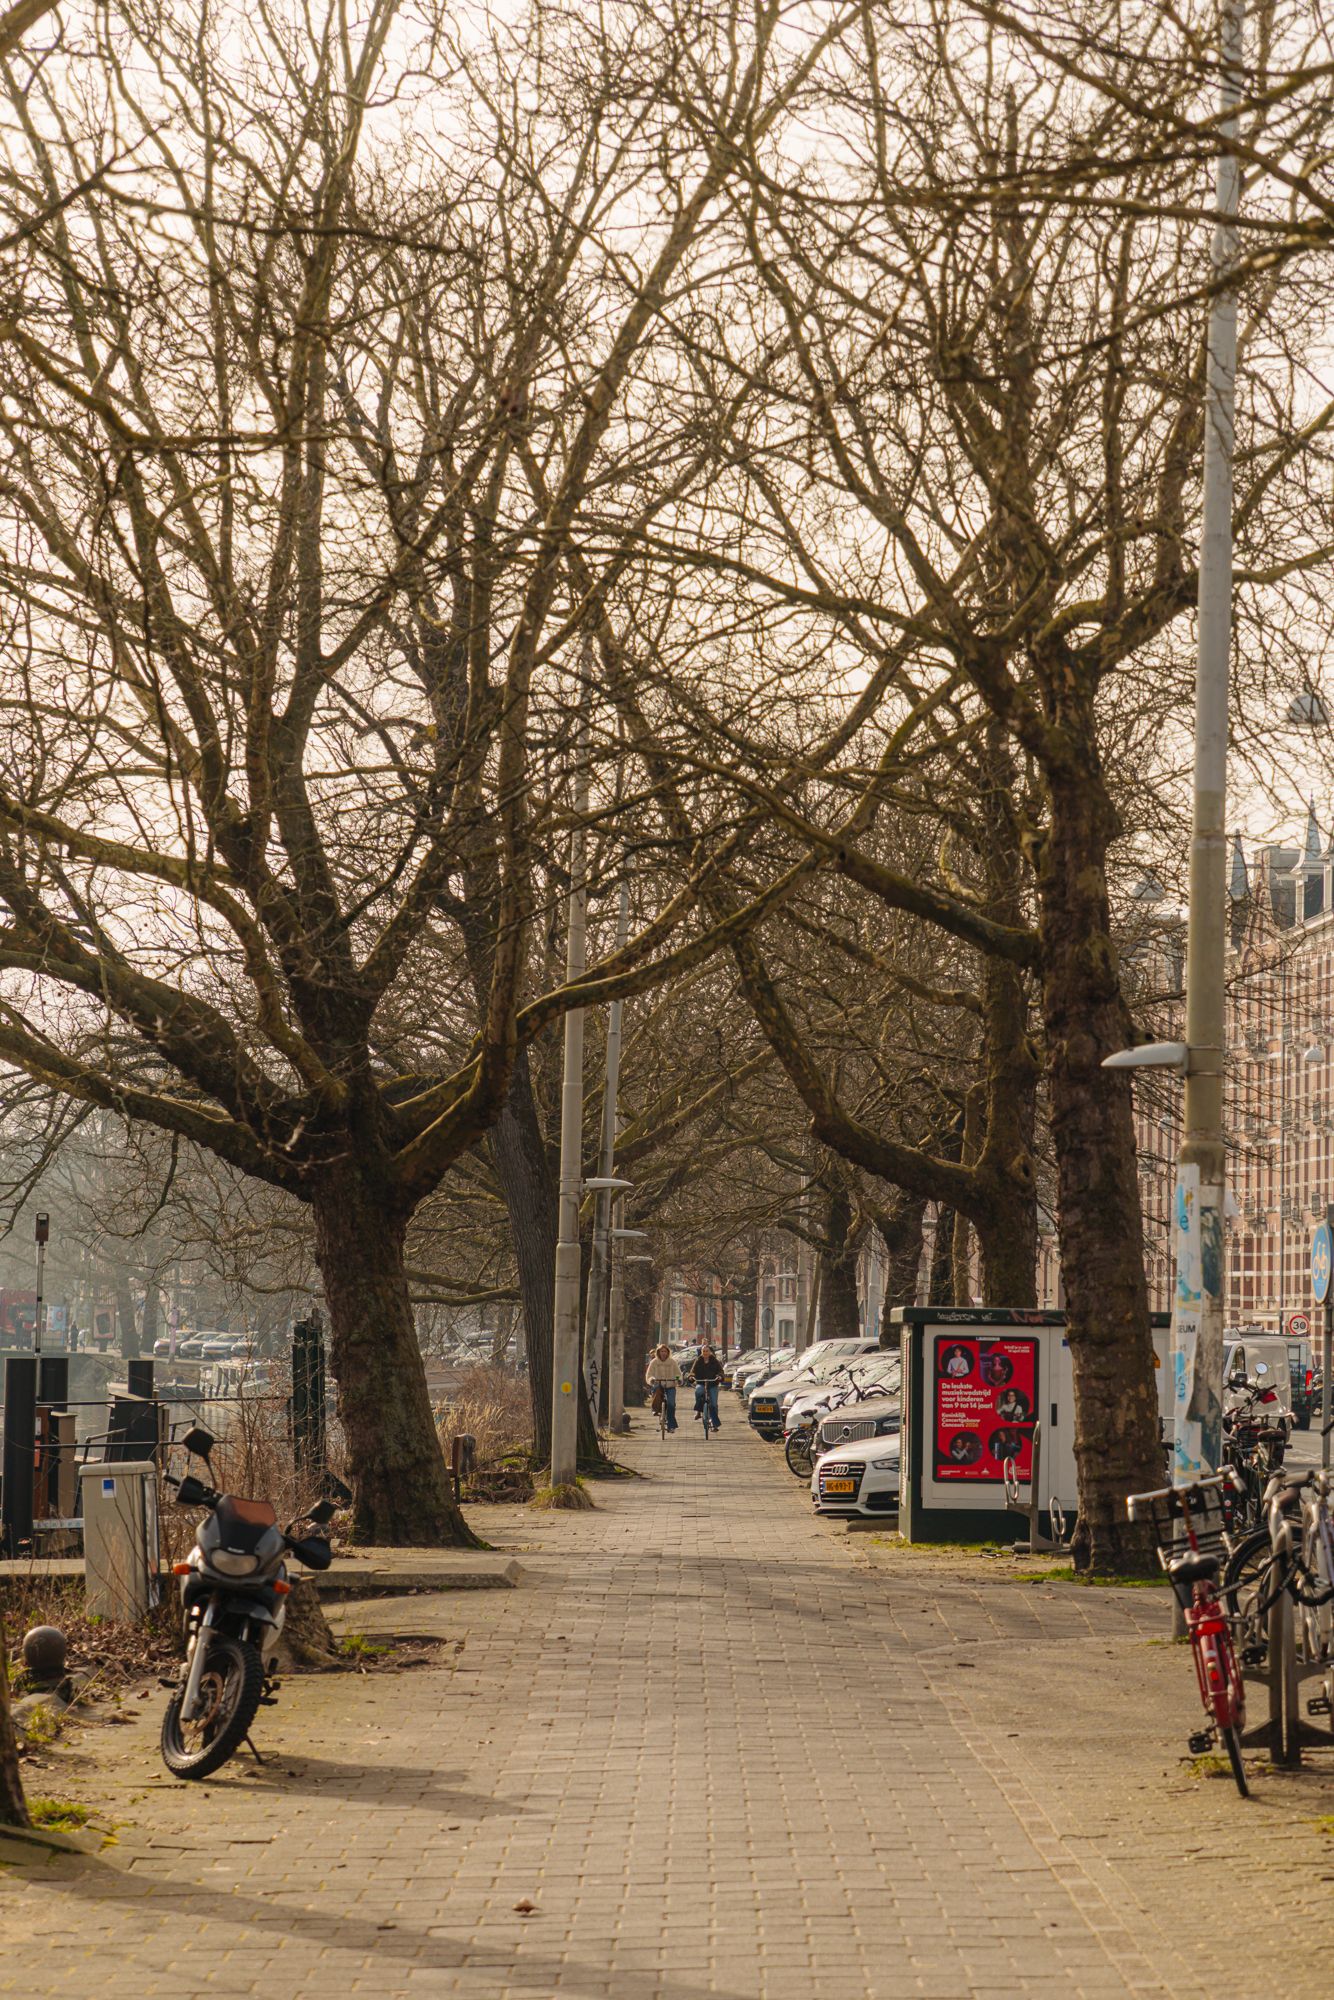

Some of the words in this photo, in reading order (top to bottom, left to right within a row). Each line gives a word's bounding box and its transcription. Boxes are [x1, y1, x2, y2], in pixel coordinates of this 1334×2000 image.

[1292, 1321, 1307, 1330] 30
[941, 1382, 951, 1390] De
[951, 1382, 973, 1390] leukste
[941, 1388, 992, 1398] muziekwedstrijd
